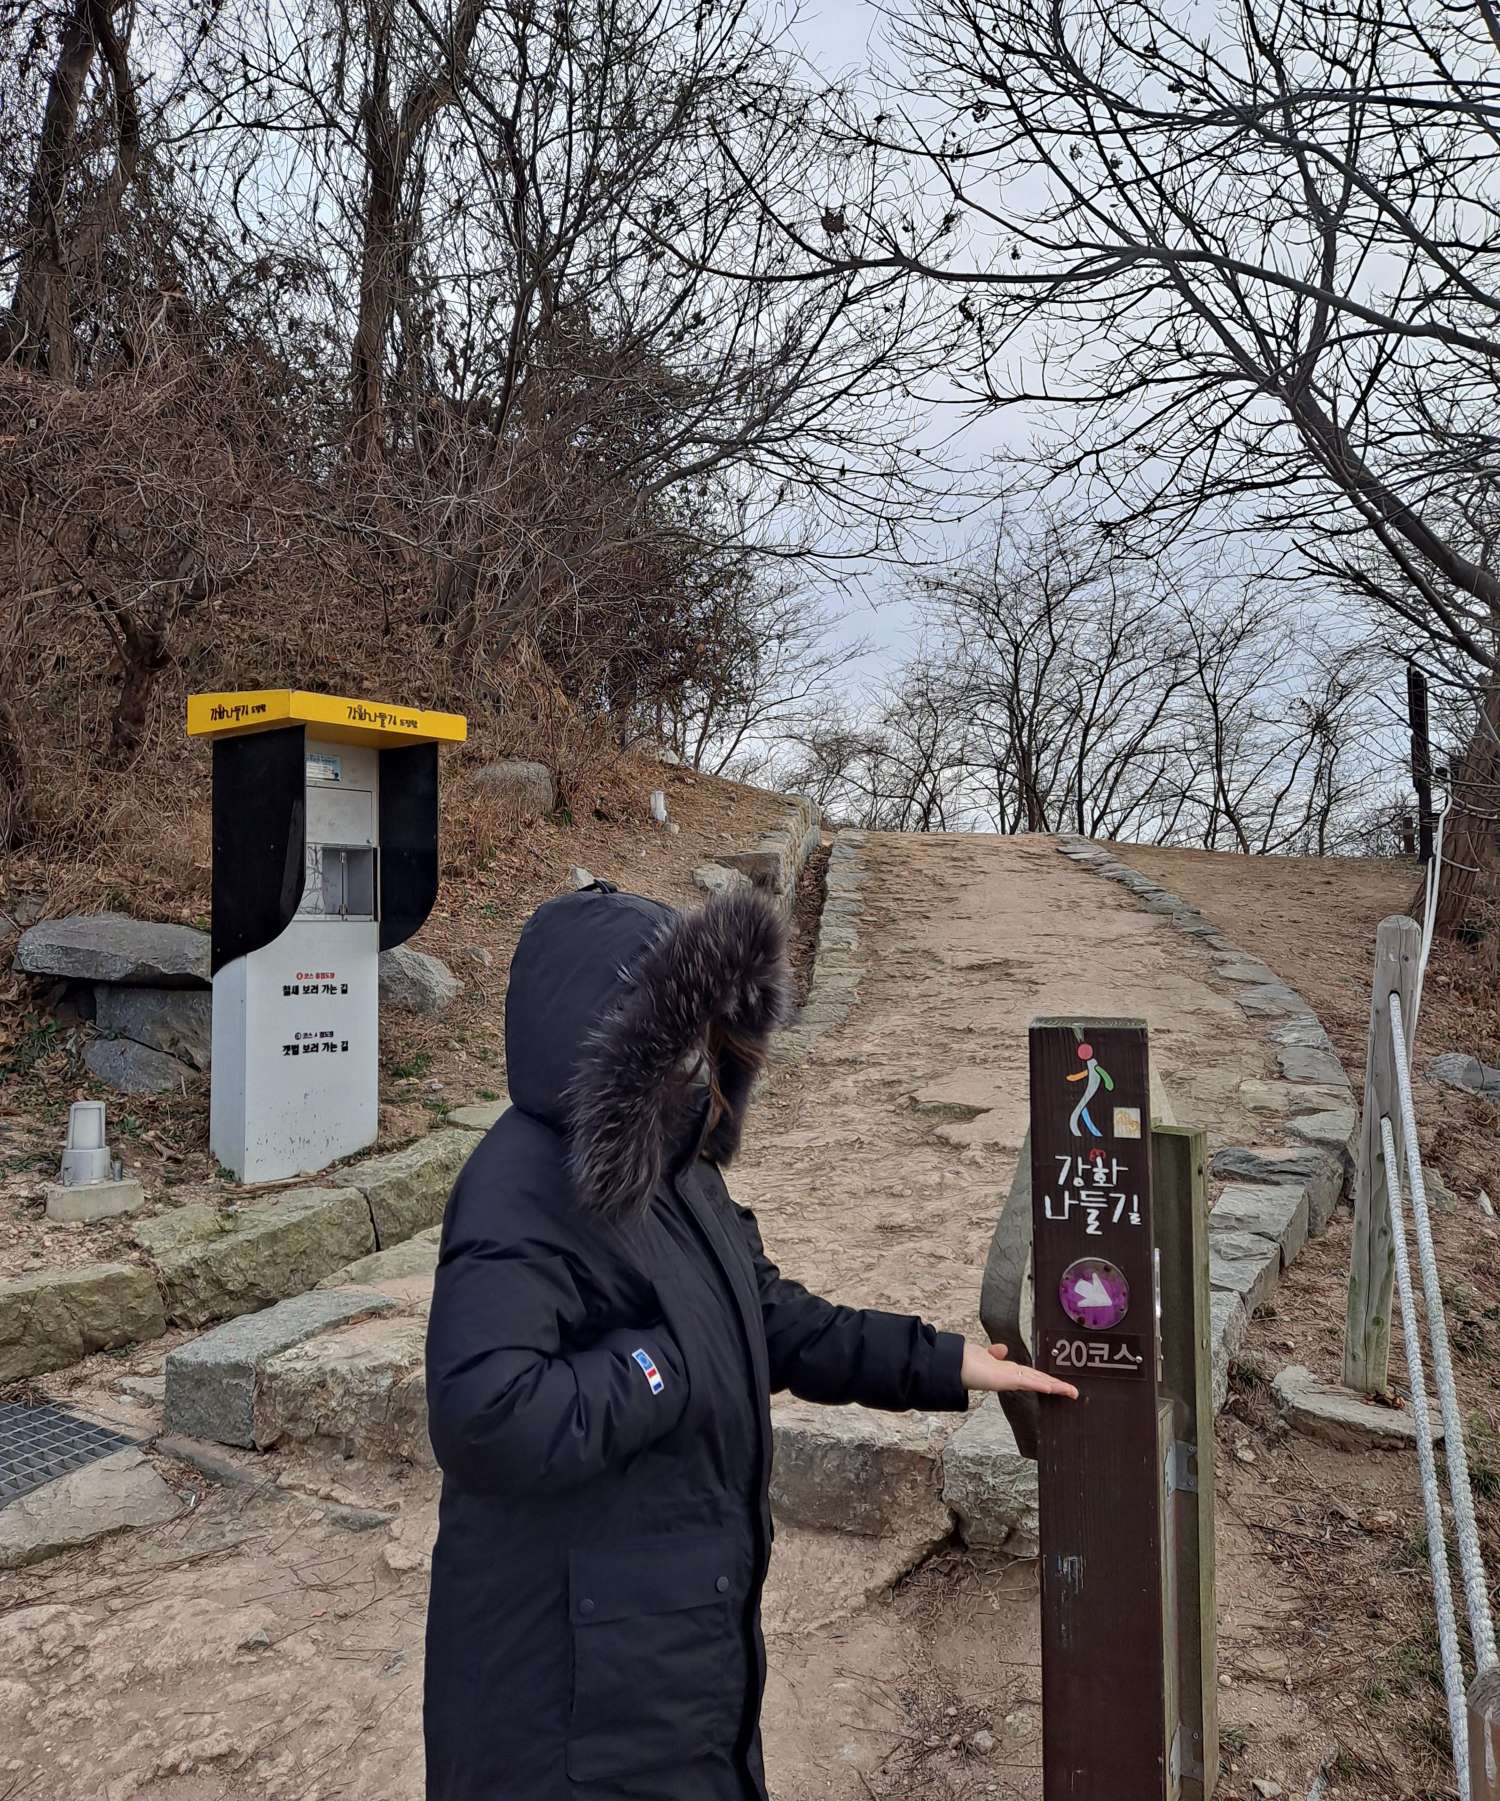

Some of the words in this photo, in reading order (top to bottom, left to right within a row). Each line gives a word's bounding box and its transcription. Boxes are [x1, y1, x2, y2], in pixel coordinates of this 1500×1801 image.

[346, 705, 397, 728] 강화나들길
[302, 984, 319, 995] 보러
[321, 983, 338, 995] 가는
[340, 983, 348, 994] 길
[302, 1042, 319, 1053] 보러
[321, 1041, 338, 1053] 가는
[340, 1040, 348, 1052] 길
[1055, 1156, 1128, 1187] 강화
[1044, 1190, 1142, 1235] 나들길
[1055, 1339, 1138, 1370] 20코스
